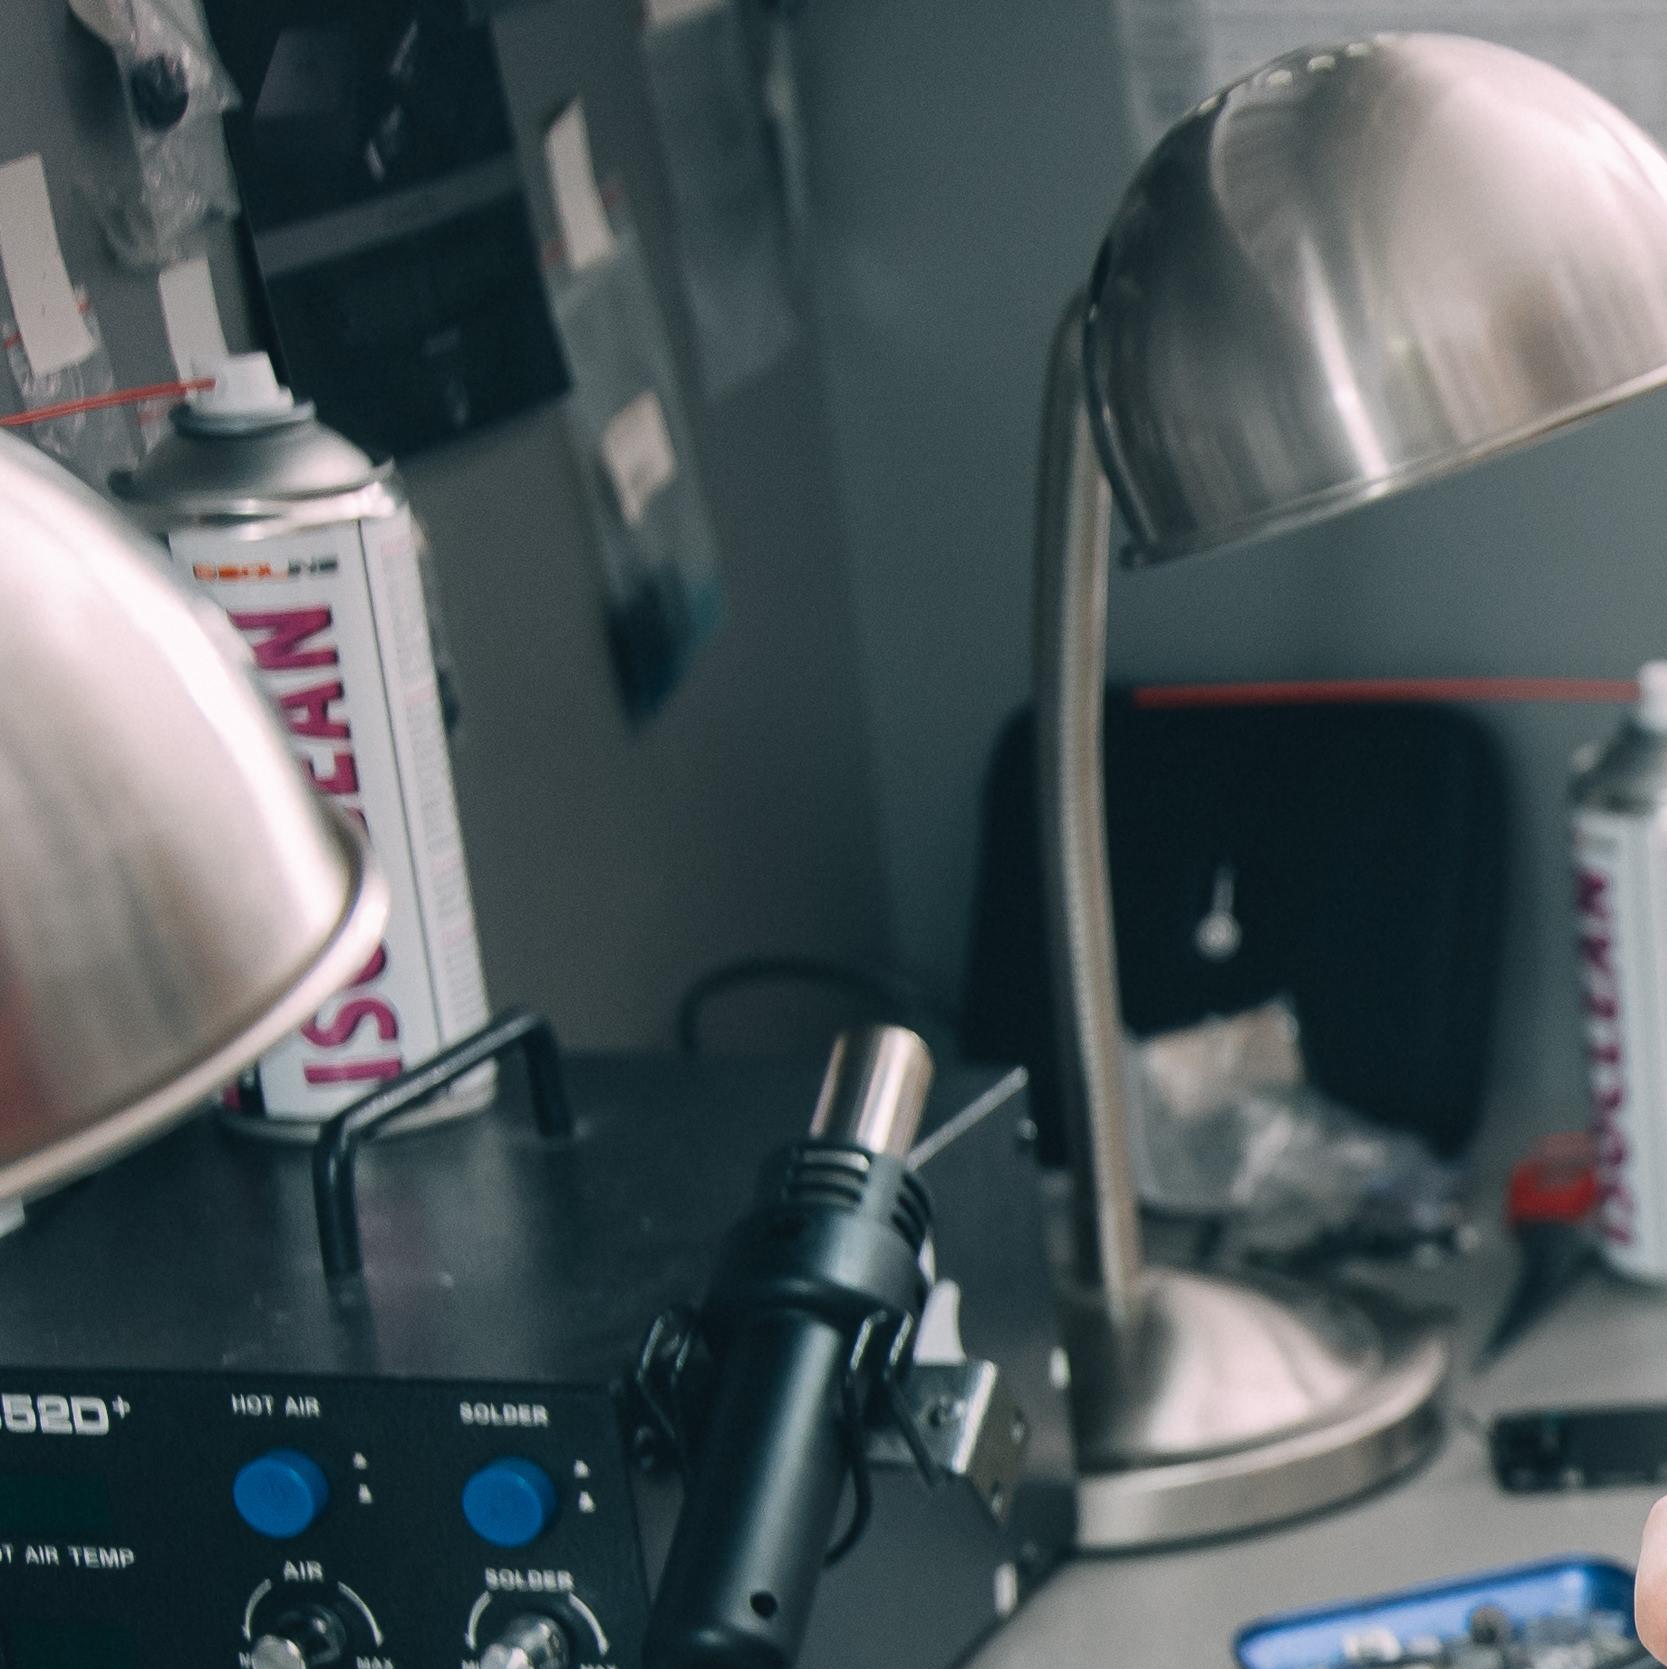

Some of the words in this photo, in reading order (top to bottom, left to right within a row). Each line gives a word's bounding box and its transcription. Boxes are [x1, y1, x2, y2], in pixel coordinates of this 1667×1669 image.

[227, 603, 405, 1086] ISEAN
[0, 1393, 132, 1435] 52D+
[231, 1393, 274, 1417] HOT
[285, 1396, 321, 1418] AIR
[459, 1400, 550, 1428] SOLDER
[25, 1545, 60, 1566] AIR
[67, 1546, 136, 1569] TEMP
[283, 1560, 324, 1582] AIR
[485, 1567, 575, 1593] SOLDER
